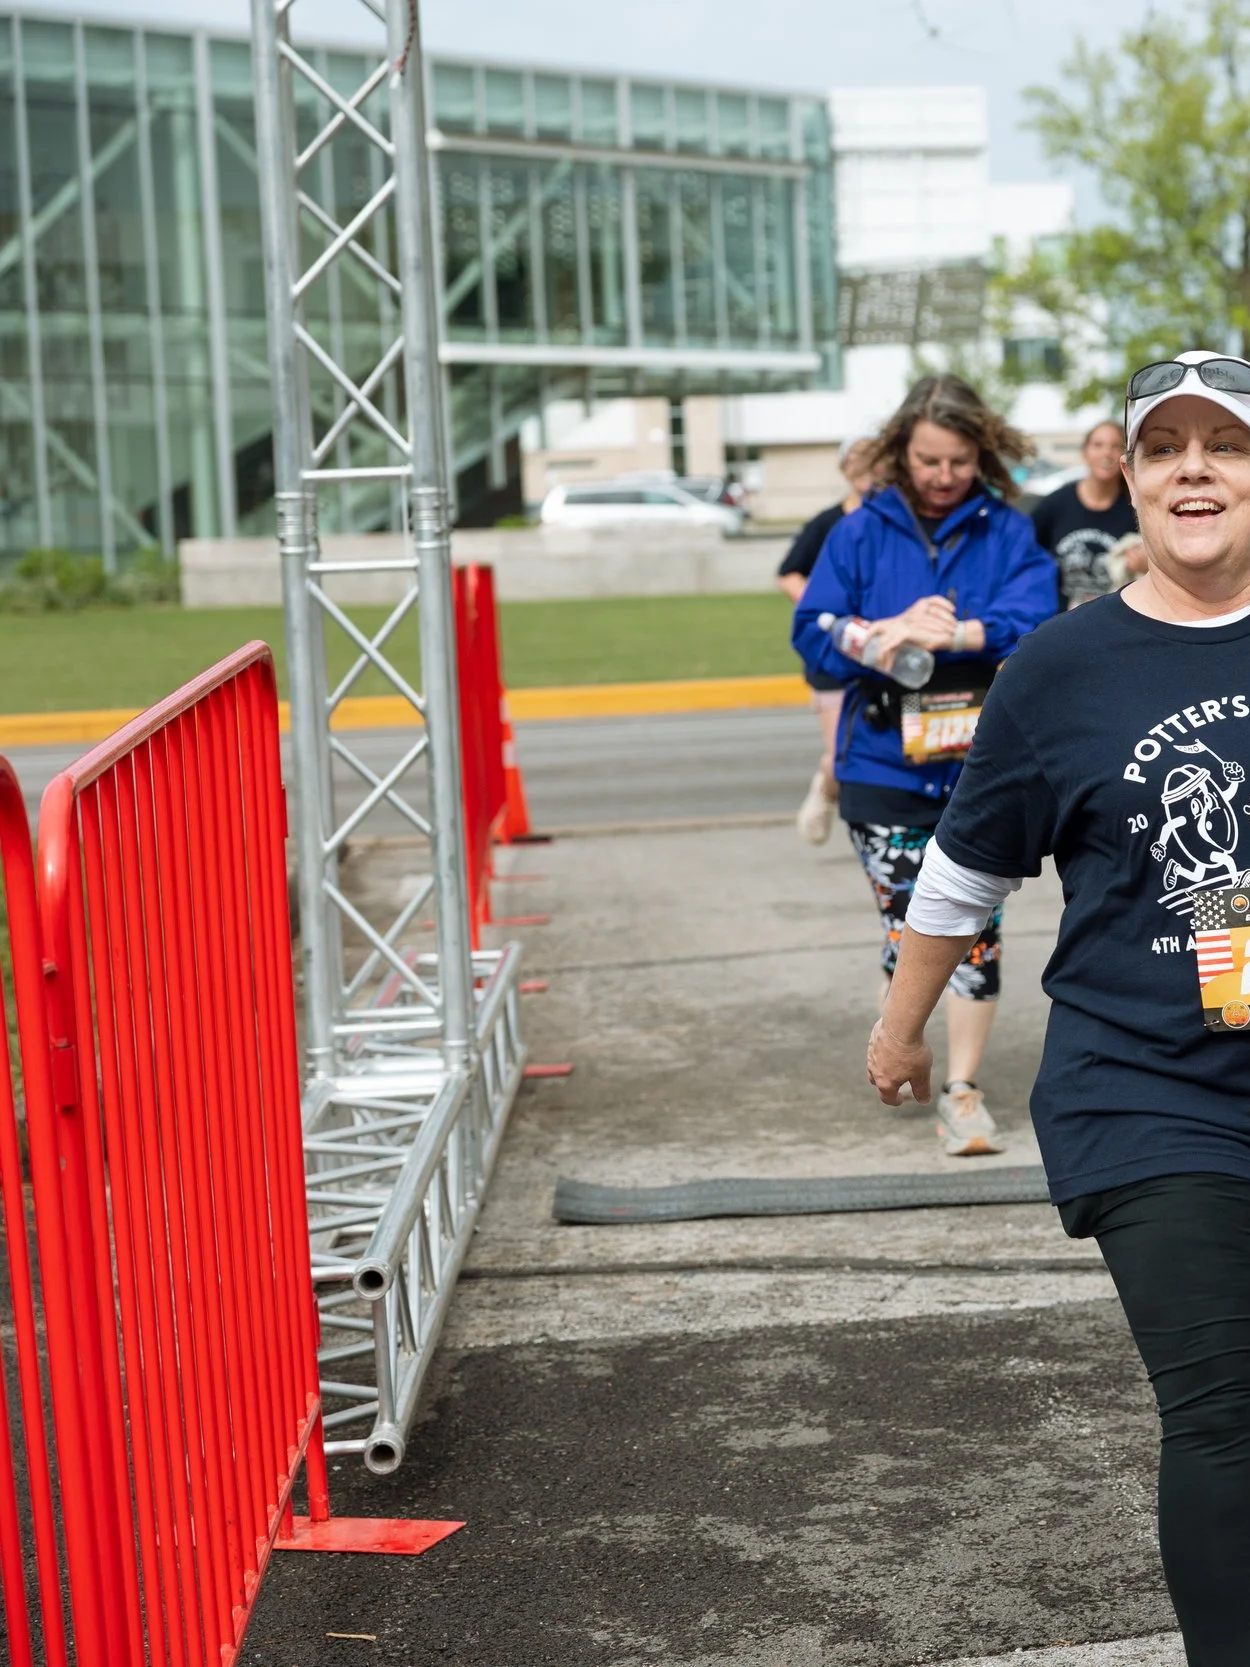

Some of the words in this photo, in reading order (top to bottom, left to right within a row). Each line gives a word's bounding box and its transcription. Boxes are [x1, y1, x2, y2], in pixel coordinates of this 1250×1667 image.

[1123, 695, 1250, 784] POTTER'S
[1127, 813, 1149, 834] 20
[1151, 936, 1180, 954] 4TH
